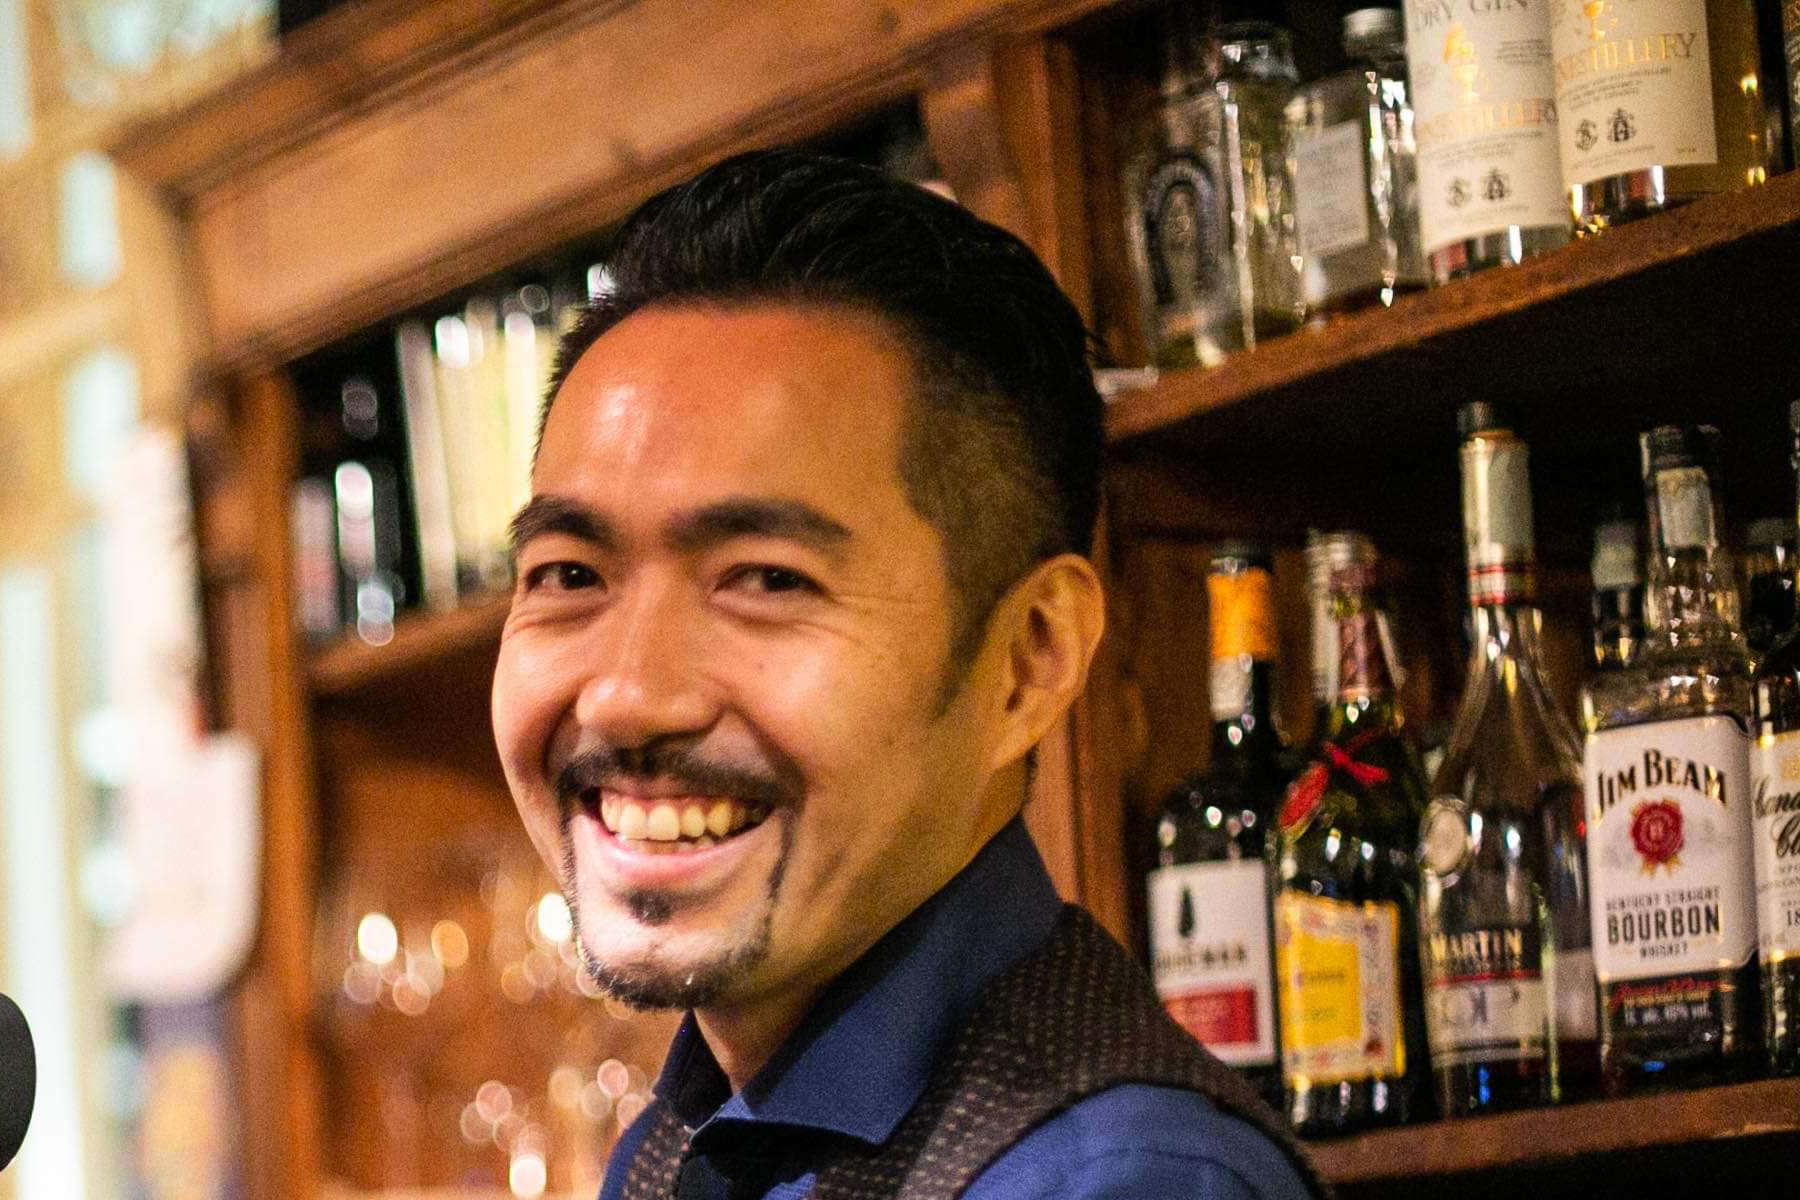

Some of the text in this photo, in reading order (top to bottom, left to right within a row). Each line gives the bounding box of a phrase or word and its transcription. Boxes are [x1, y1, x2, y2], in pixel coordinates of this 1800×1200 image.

[1595, 748, 1728, 815] JIM BEAM
[1664, 885, 1720, 905] STRAIGHT
[1607, 902, 1720, 945] BOURBON
